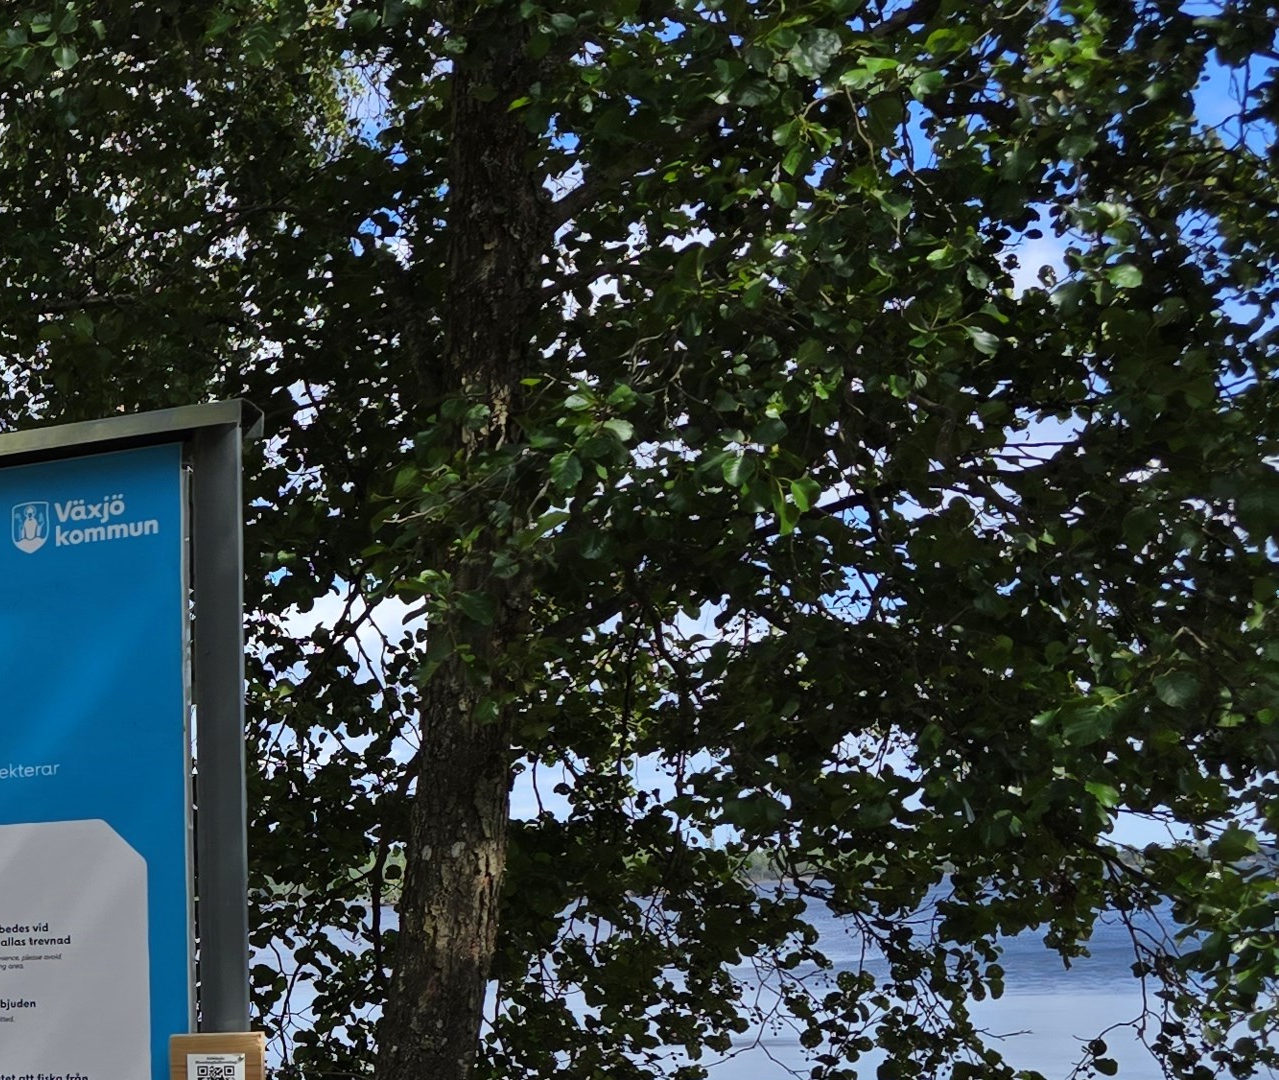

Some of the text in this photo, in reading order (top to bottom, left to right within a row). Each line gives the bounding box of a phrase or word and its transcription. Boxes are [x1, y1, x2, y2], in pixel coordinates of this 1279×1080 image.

[54, 494, 125, 523] Växjö
[56, 519, 159, 546] kommun
[33, 923, 48, 932] vid
[1, 938, 26, 947] allas
[30, 936, 71, 945] trevnad
